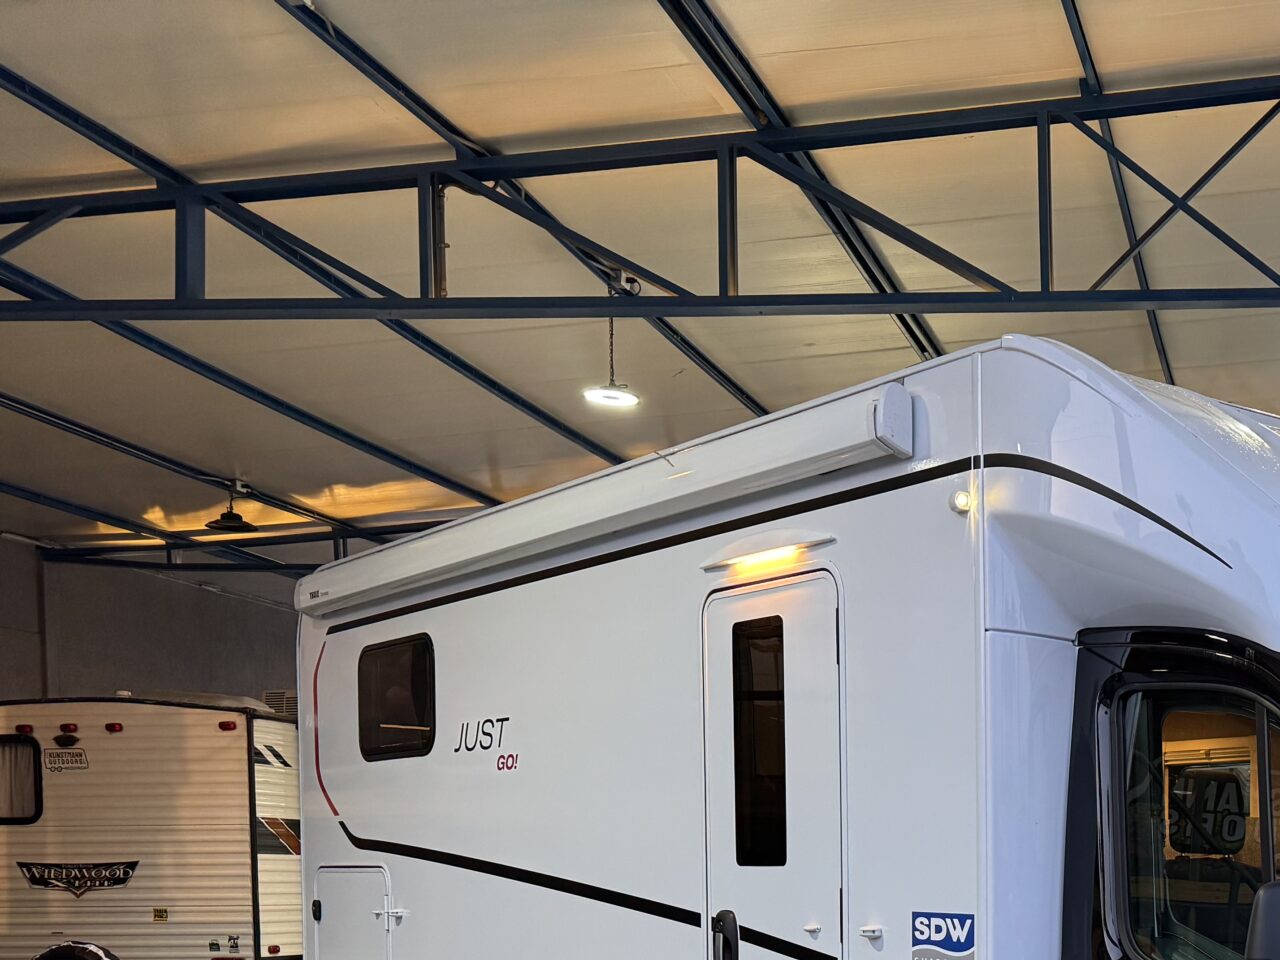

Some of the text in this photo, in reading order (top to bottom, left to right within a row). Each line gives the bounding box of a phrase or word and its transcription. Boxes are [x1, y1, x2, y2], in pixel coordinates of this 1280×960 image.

[454, 717, 510, 752] JUST
[497, 753, 518, 771] GO!
[22, 867, 133, 879] WILDWOOD
[914, 917, 972, 943] SDW
